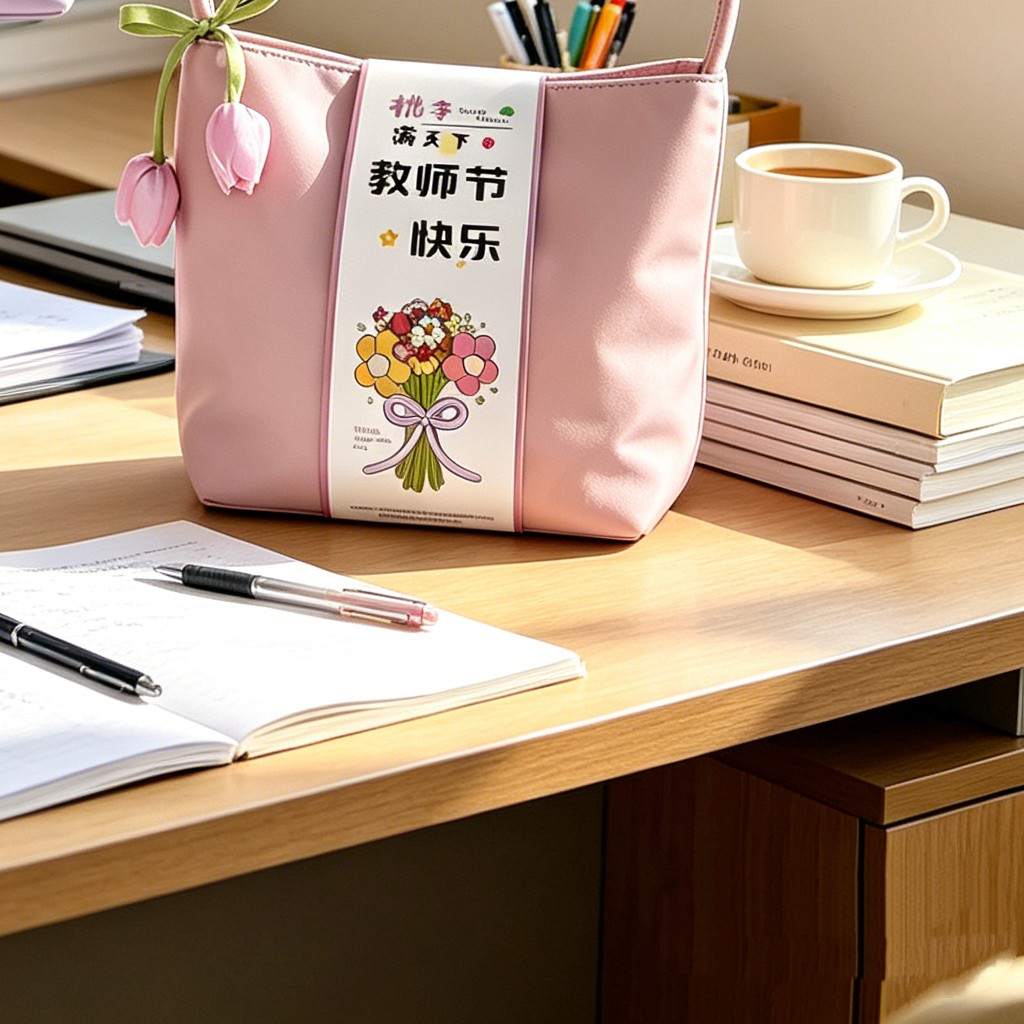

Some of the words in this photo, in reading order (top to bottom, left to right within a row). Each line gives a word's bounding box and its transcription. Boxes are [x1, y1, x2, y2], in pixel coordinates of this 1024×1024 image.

[368, 159, 509, 202] 教师节
[410, 219, 501, 262] 快乐
